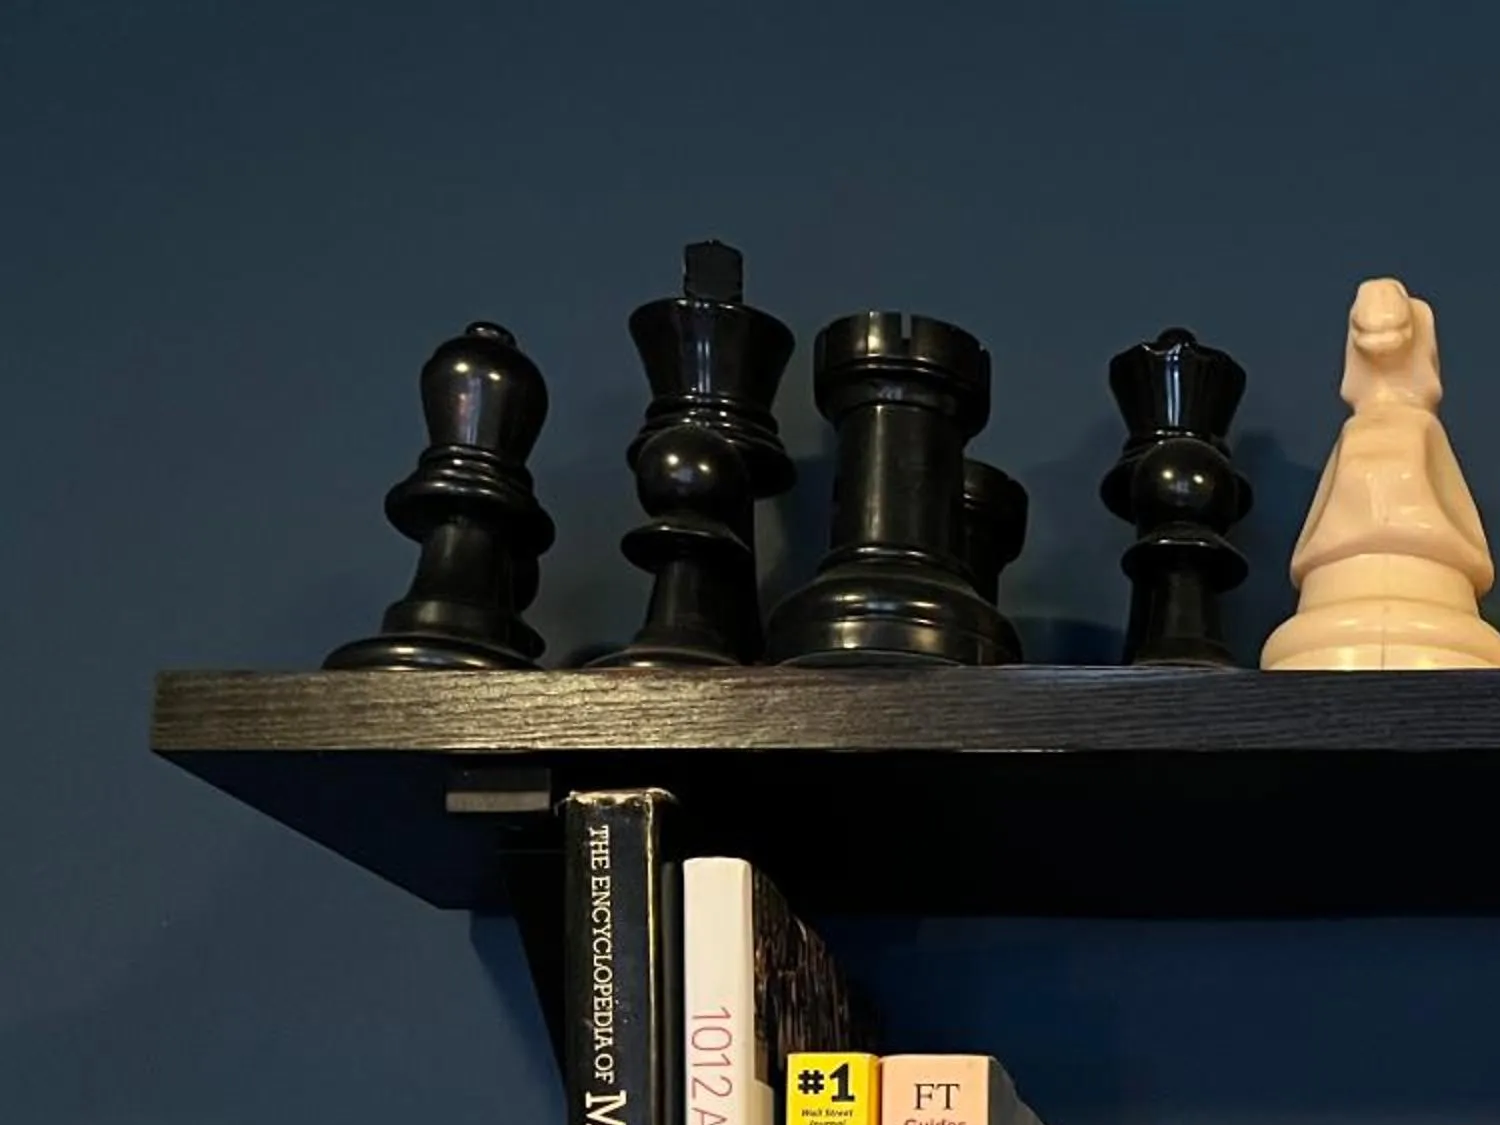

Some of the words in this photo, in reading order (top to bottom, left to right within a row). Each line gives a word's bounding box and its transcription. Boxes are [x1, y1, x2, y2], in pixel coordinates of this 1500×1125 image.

[589, 824, 611, 870] THE
[591, 875, 614, 1051] ENCYCLOPEDIA
[594, 1053, 615, 1085] OF
[797, 1062, 856, 1103] #1
[801, 1109, 824, 1117] Wall
[825, 1109, 853, 1117] Street
[914, 1083, 960, 1110] FT
